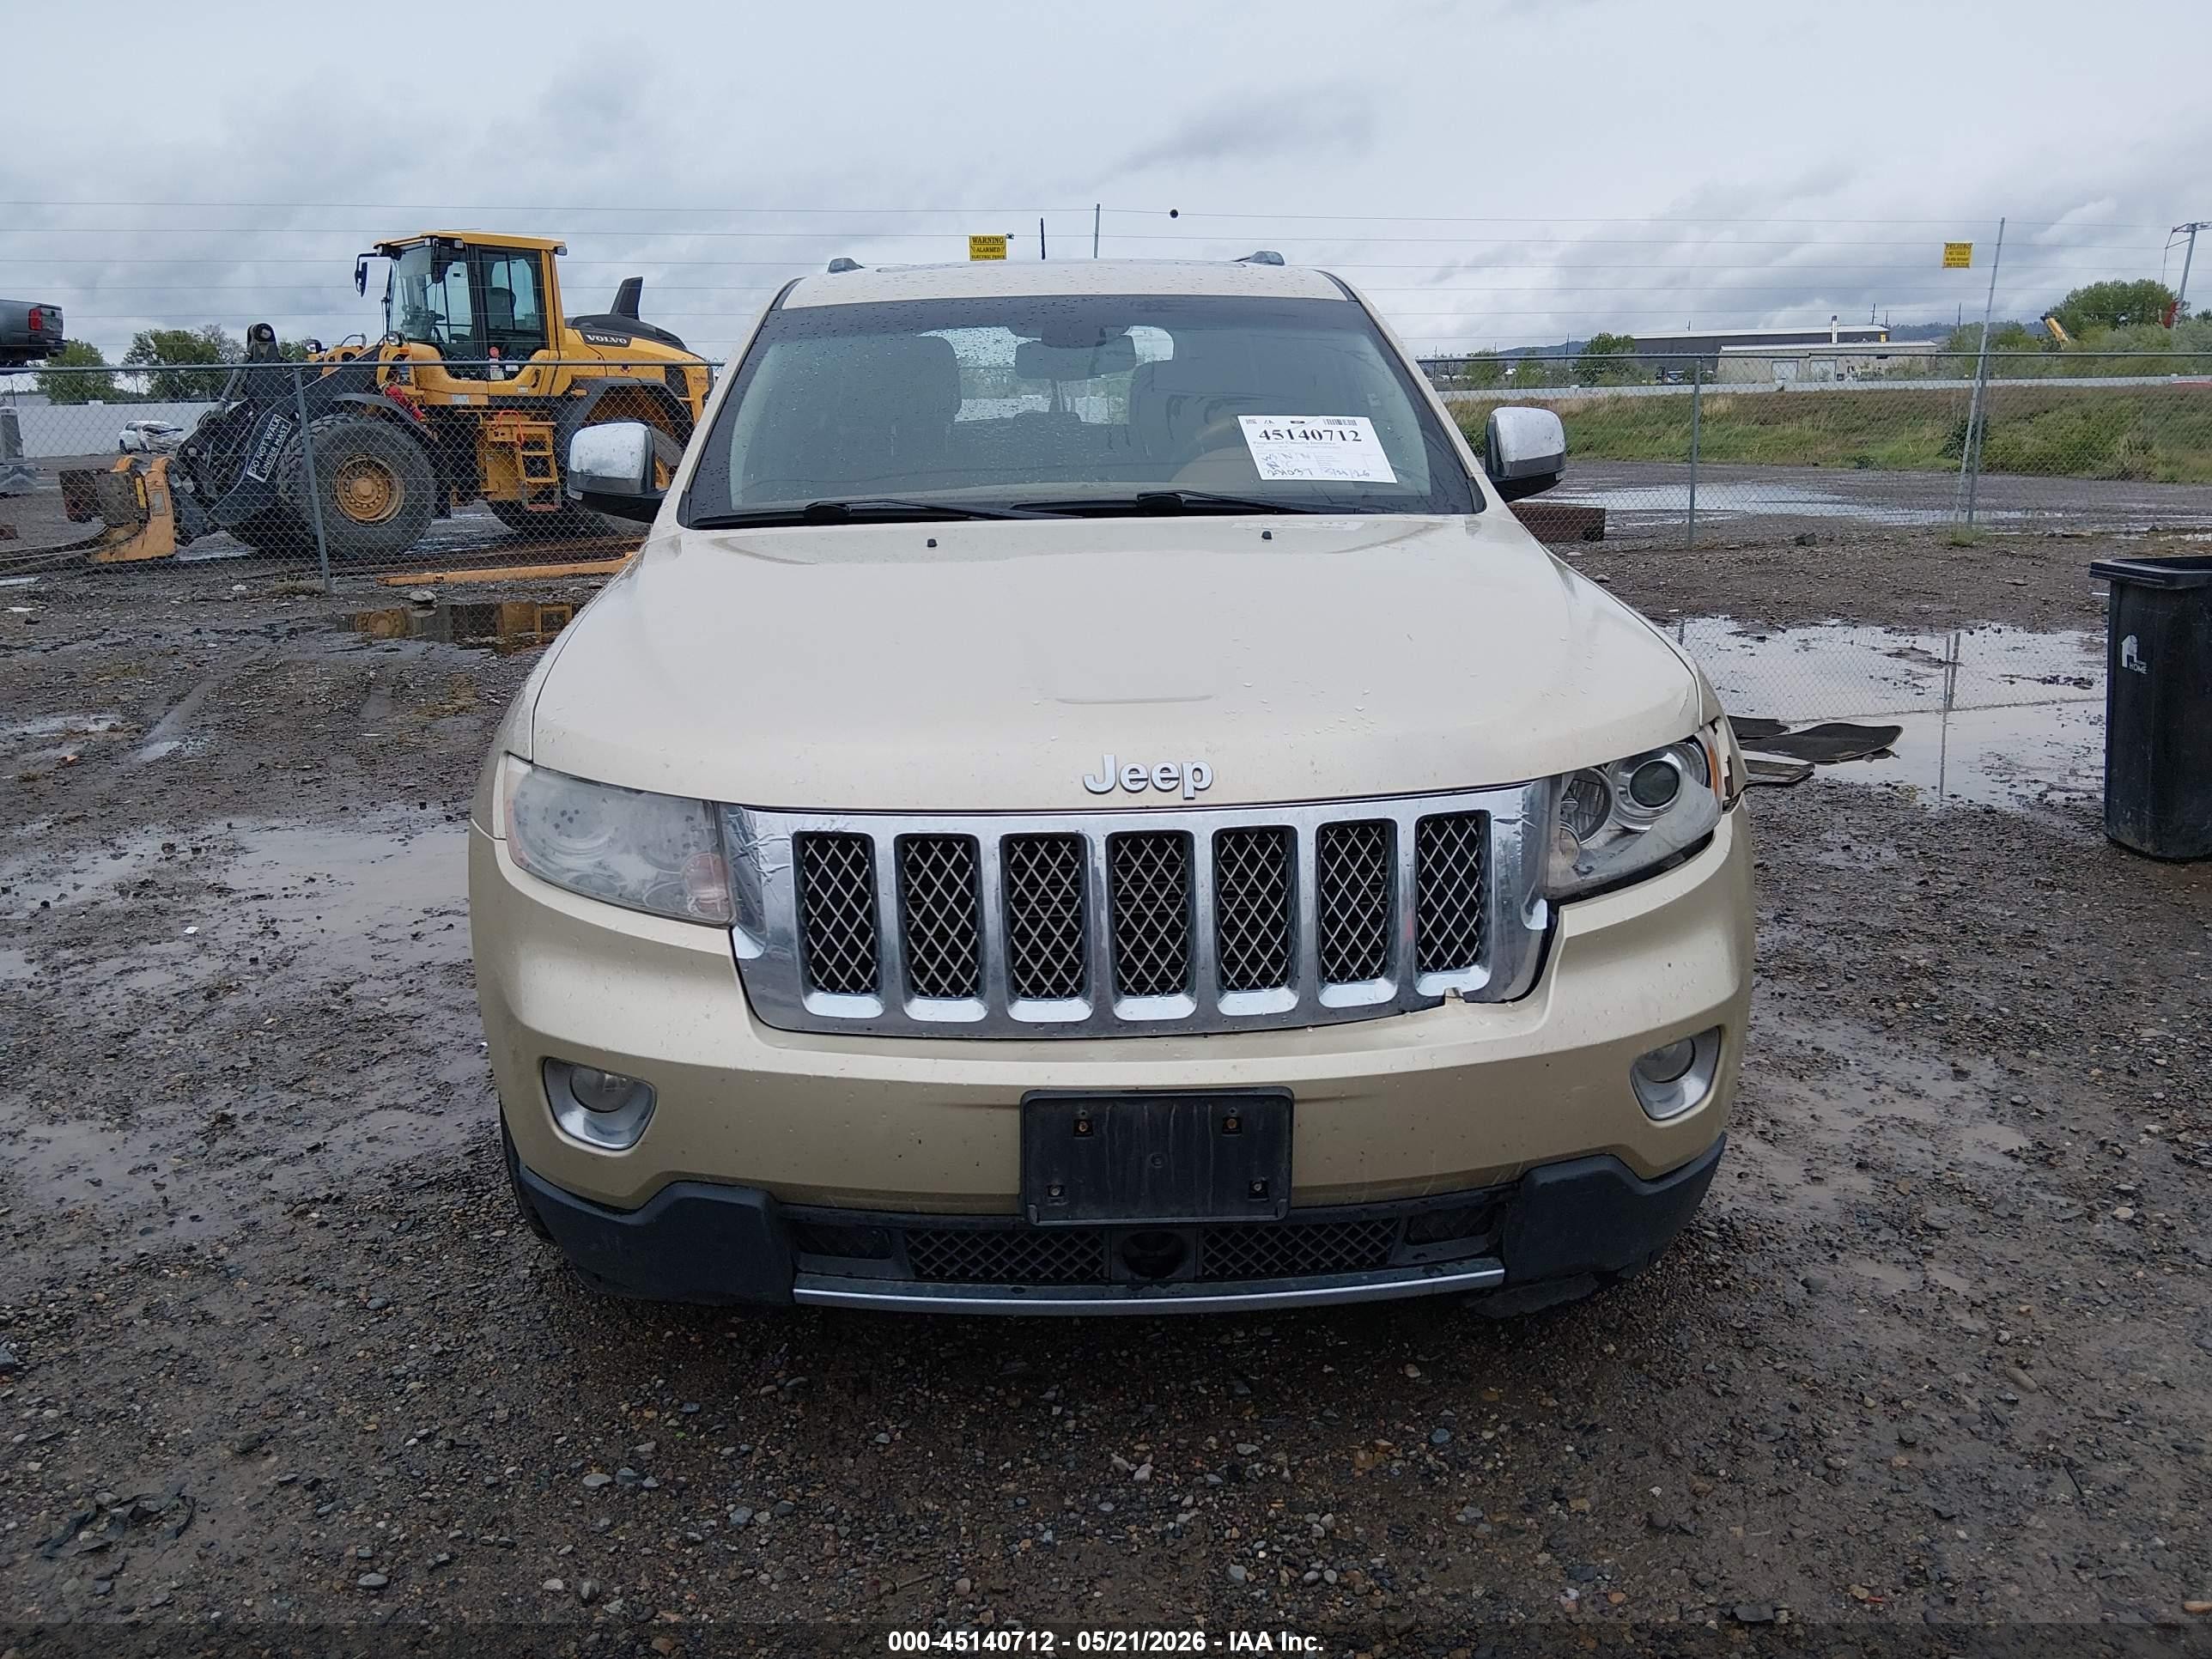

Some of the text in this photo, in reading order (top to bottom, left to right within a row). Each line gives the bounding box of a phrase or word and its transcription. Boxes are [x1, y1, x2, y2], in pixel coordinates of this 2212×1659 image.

[586, 335, 628, 344] VOLVO
[250, 416, 281, 473] DO NOT WALK
[261, 424, 289, 473] UNDER MAST
[1259, 428, 1363, 442] 45140712
[2129, 661, 2148, 675] HOME
[1083, 755, 1213, 800] Jeep
